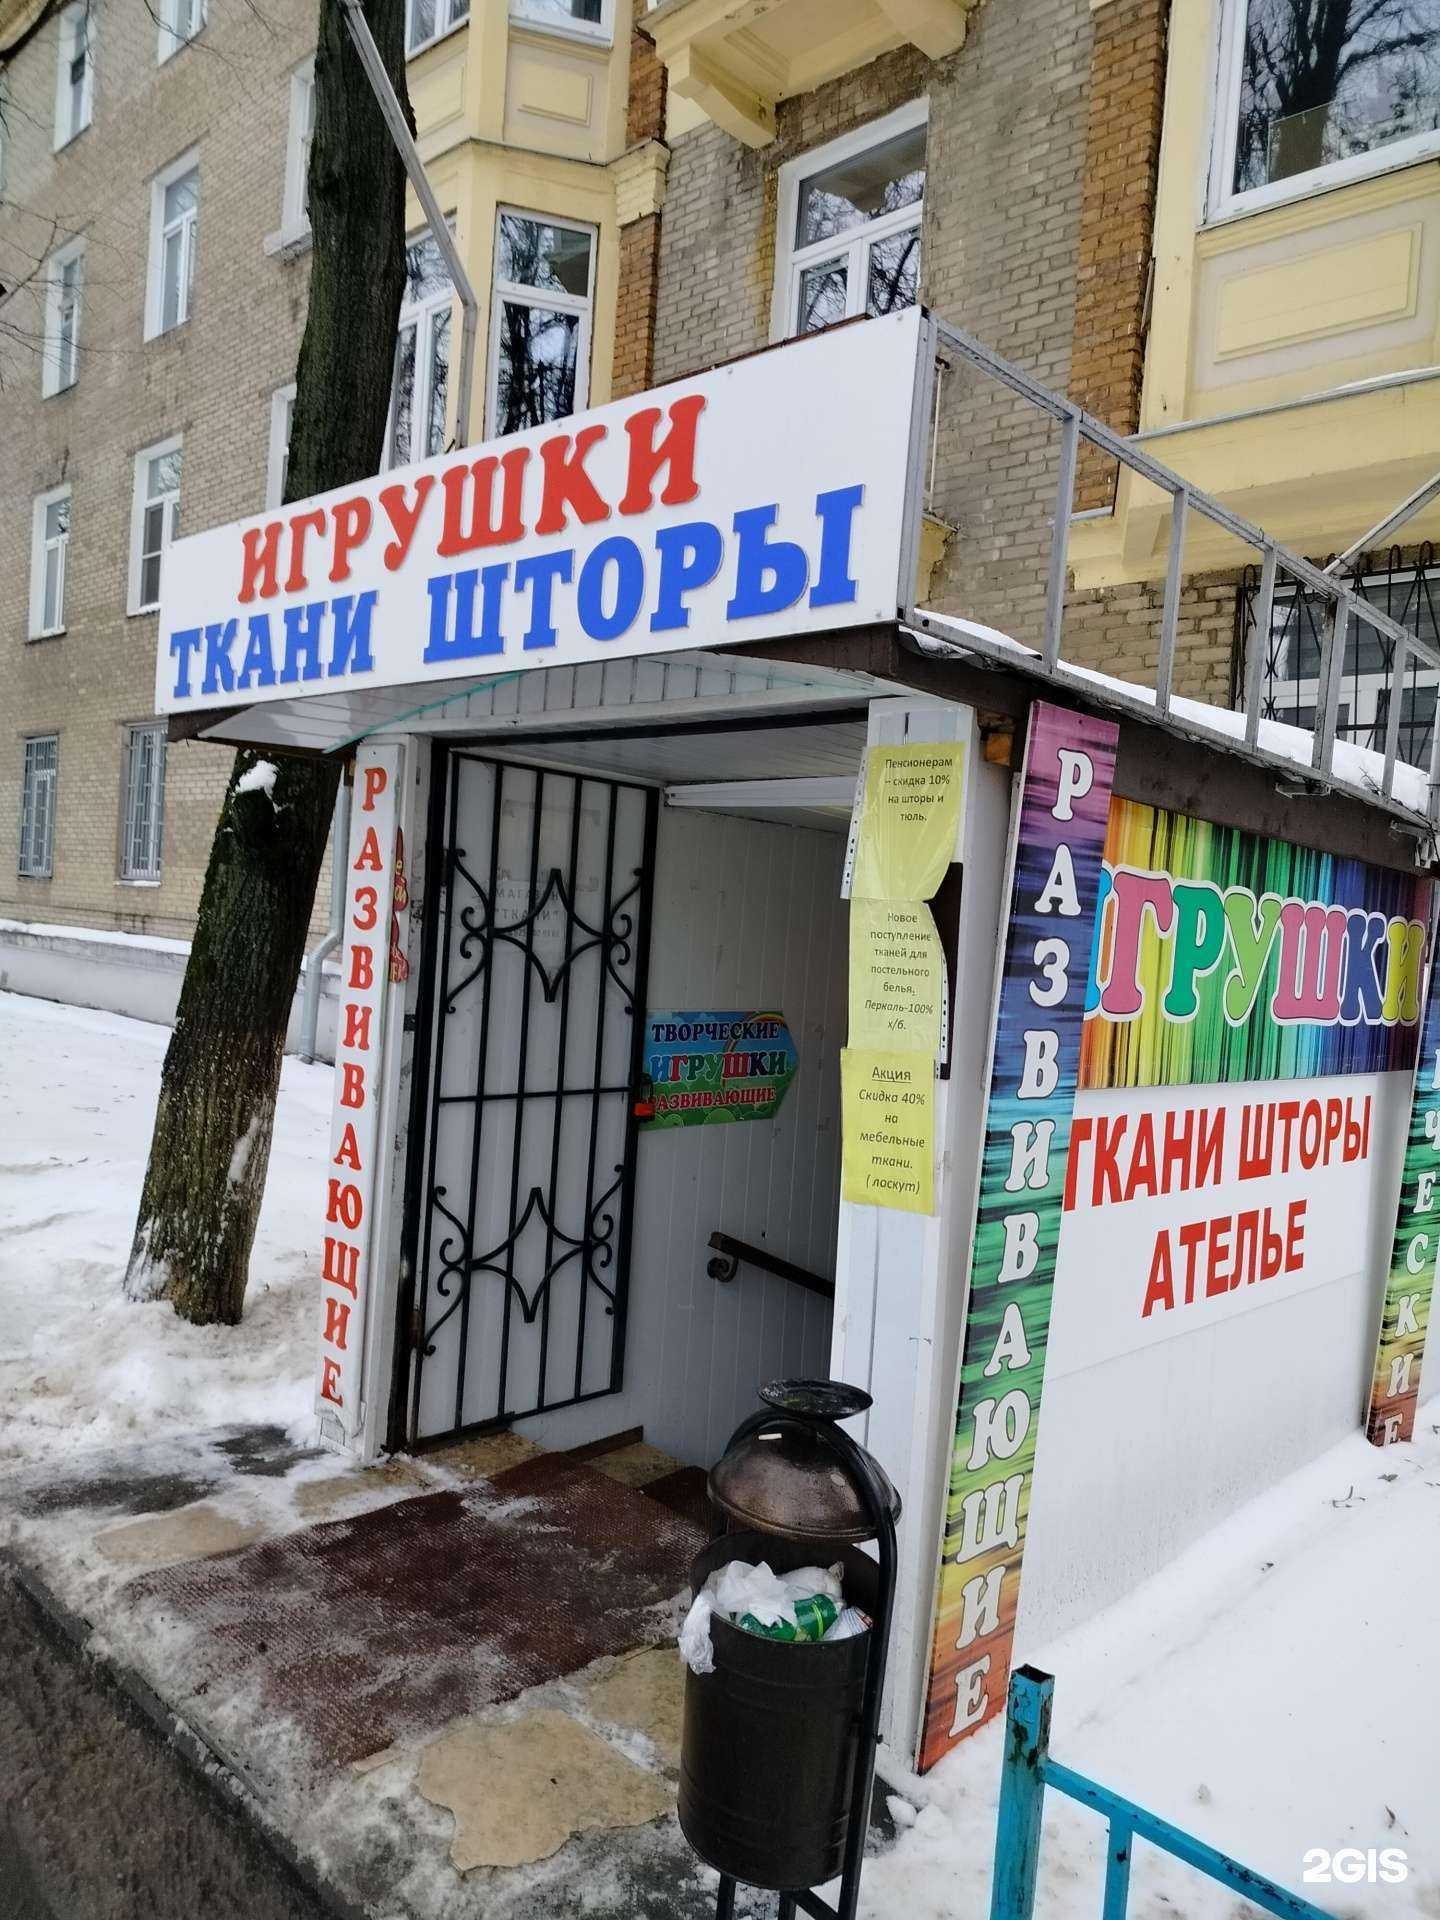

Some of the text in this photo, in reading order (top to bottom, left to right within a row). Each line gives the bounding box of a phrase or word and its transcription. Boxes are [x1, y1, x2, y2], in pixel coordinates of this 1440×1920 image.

[237, 395, 706, 603] ИГРУШКИ
[170, 484, 866, 699] ТКАНИ ШТОРЫ
[885, 758, 953, 769] Пенсионерам
[893, 777, 926, 787] скидка
[929, 775, 950, 785] 10%
[888, 795, 944, 805] на шторы и
[900, 813, 927, 821] тюль.
[887, 913, 918, 923] Новое
[870, 930, 931, 942] поступление
[875, 948, 927, 960] тканей для
[871, 965, 930, 977] постельного
[652, 1022, 780, 1043] ТВОРЧЕСКИЕ
[650, 1051, 787, 1083] ИГРУШКИ
[872, 1066, 911, 1082] Акция
[321, 767, 387, 1407] РАЗВИВАЮЩИЕ
[859, 1089, 925, 1105] Скидка 40%
[884, 1113, 898, 1124] на
[860, 1132, 925, 1148] мебельные
[1237, 1096, 1372, 1181] ШТОРЫ
[872, 1155, 913, 1169] ткани.
[948, 748, 1095, 1738] РАЗВИВАЮЩИЕ
[1141, 1198, 1308, 1318] АТЕЛЬЕ
